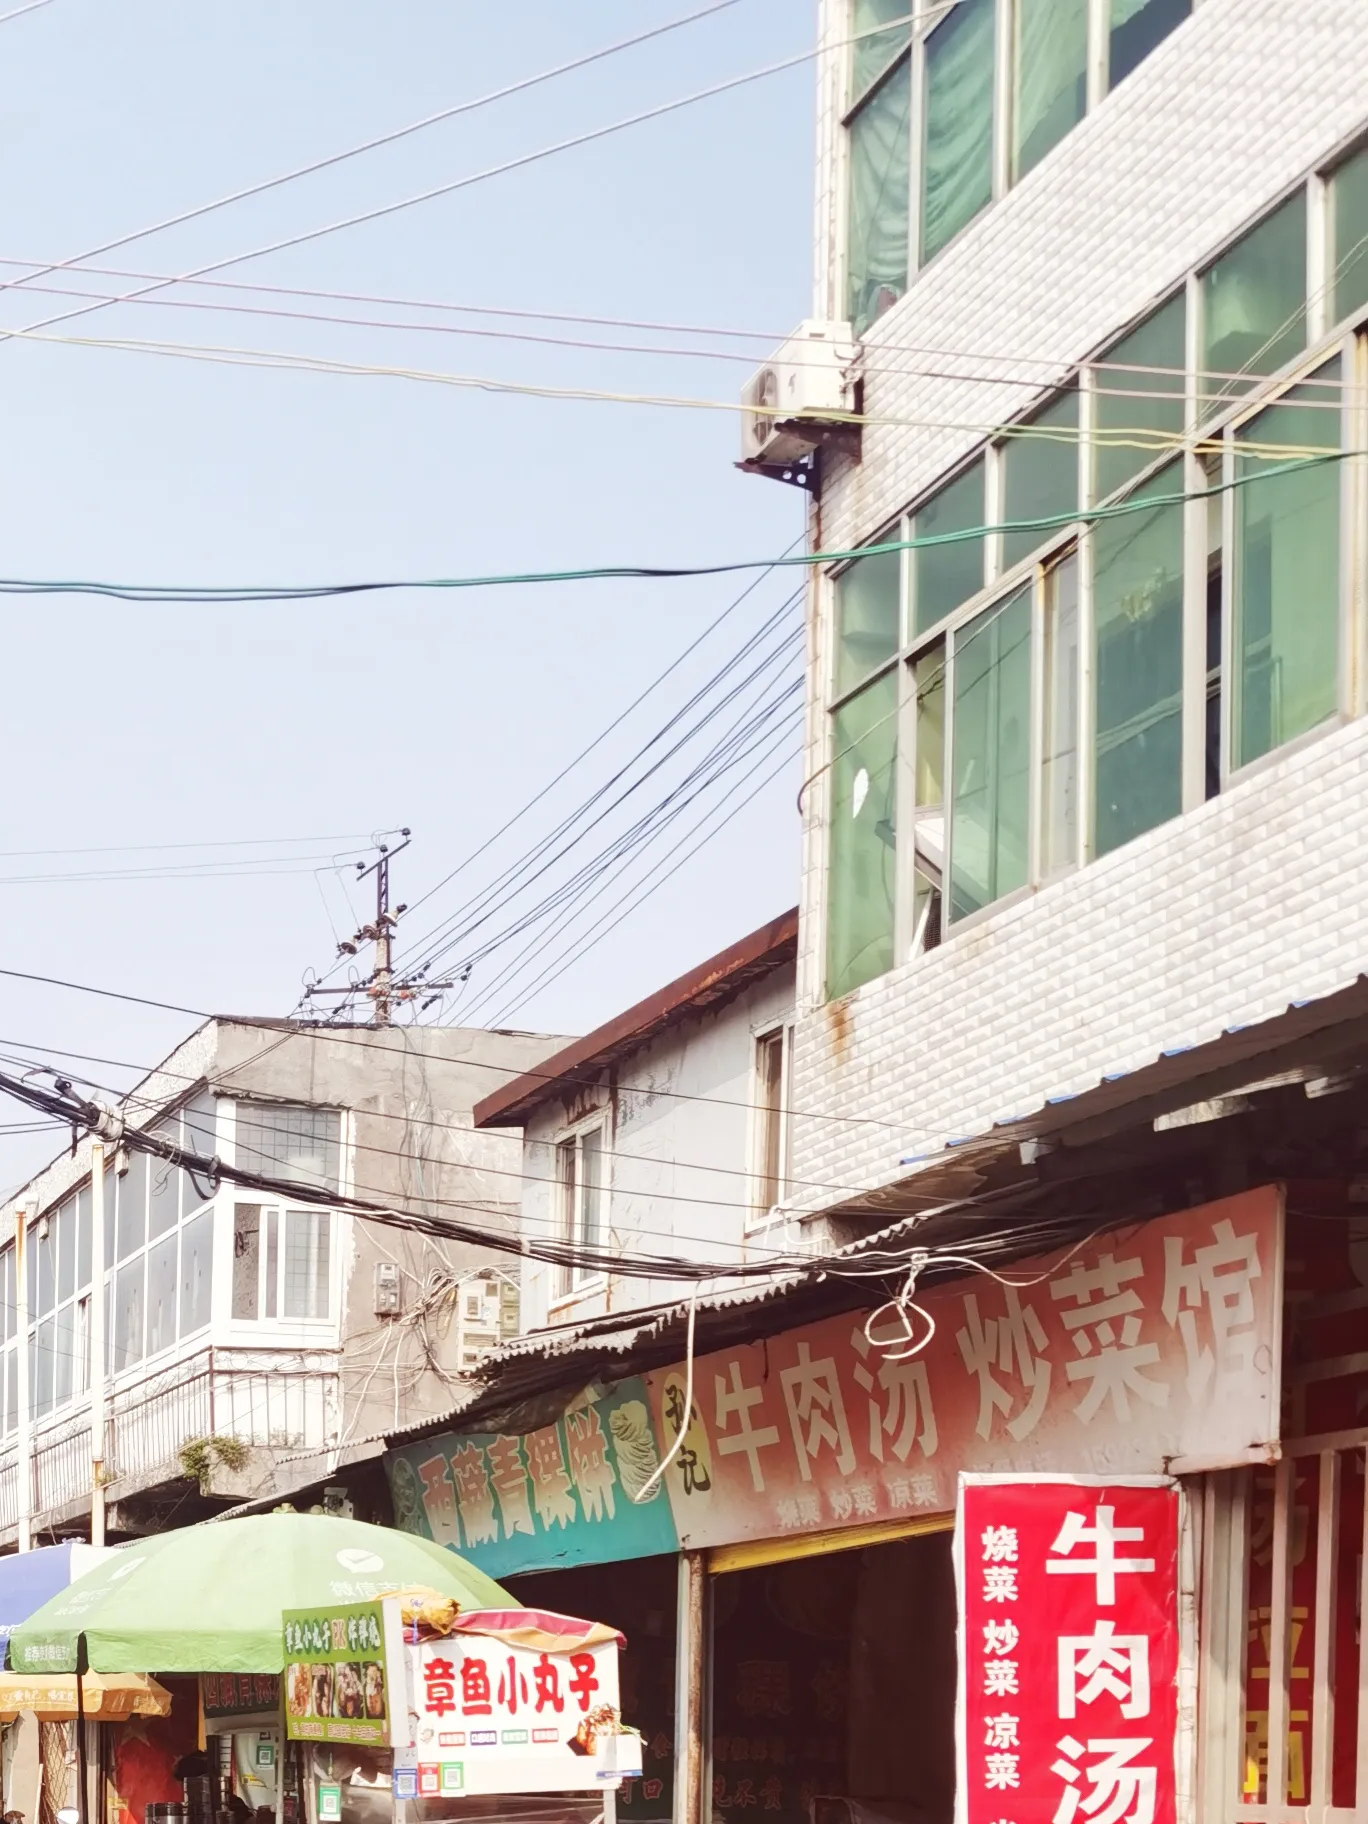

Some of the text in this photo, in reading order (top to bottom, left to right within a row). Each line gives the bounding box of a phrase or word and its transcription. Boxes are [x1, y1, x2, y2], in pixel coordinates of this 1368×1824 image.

[715, 1218, 1261, 1492] 牛肉汤 炒菜馆
[418, 1404, 617, 1549] 西藏青稞饼
[981, 1524, 1020, 1604] 烧菜
[424, 1653, 600, 1718] 章鱼小丸子
[982, 1619, 1021, 1697] 炒菜
[984, 1711, 1021, 1791] 凉菜
